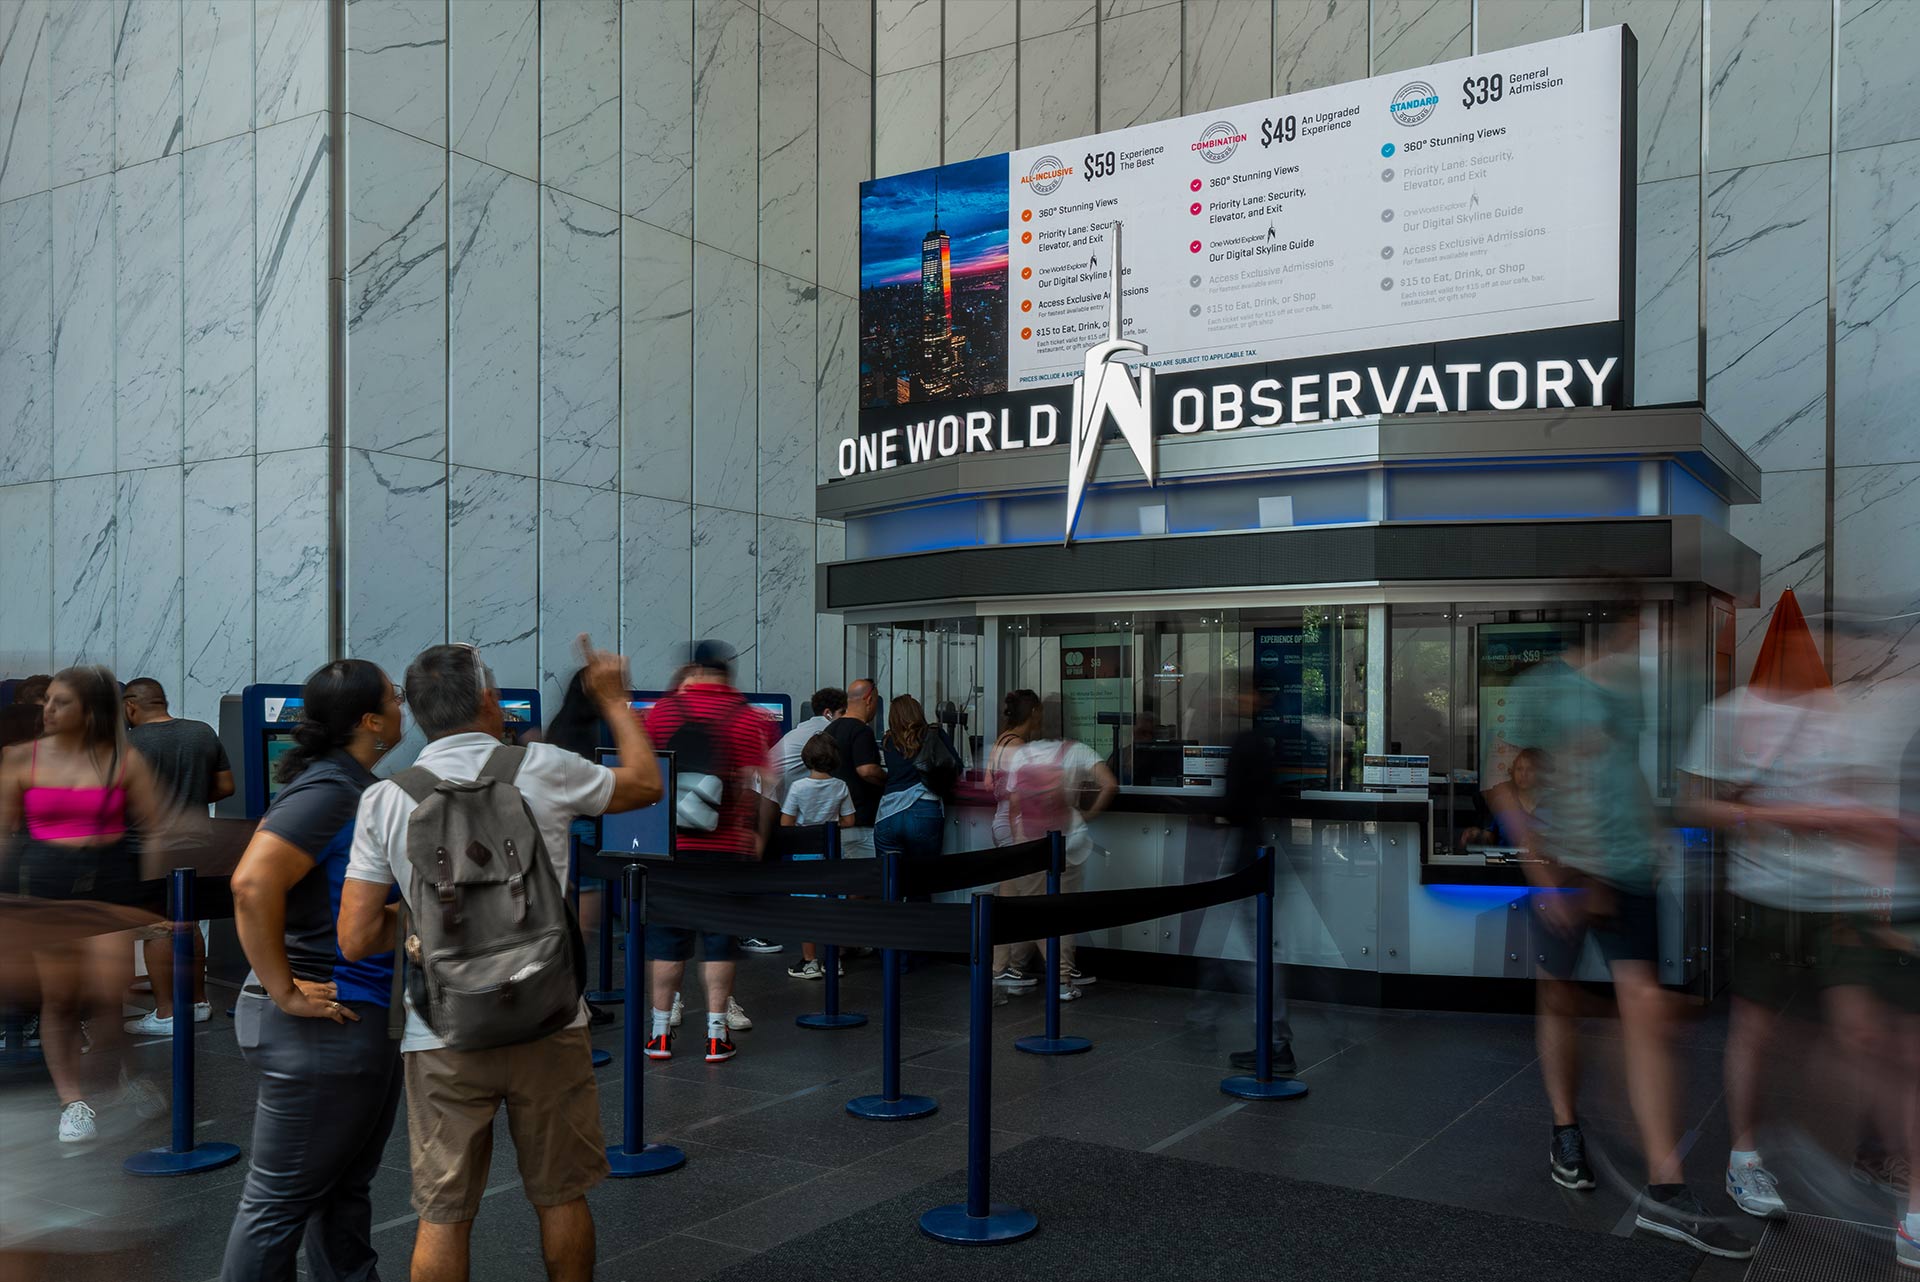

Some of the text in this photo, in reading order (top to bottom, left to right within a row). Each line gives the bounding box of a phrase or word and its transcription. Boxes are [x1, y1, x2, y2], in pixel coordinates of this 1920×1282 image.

[1509, 67, 1549, 84] General
[1462, 73, 1503, 110] $39
[1509, 78, 1563, 95] Admission
[1390, 95, 1439, 113] STANDARD
[1302, 105, 1360, 125] An Upgraded
[1261, 115, 1296, 148] $49
[1302, 120, 1351, 136] Experience
[1191, 134, 1247, 151] COMBINATION
[1403, 126, 1506, 153] 360° Stunning Views
[1120, 146, 1164, 161] Experience
[1084, 151, 1115, 182] $59
[1120, 158, 1154, 171] The Best
[1403, 150, 1514, 178] Priority Lane: Security,
[1021, 167, 1073, 184] ALL-INCLUSIVE
[1210, 165, 1299, 188] 360° Stunning Views
[1403, 168, 1487, 191] Elevator, and Exit
[1039, 198, 1118, 218] 360° Stunning Views
[1210, 188, 1306, 211] Priority Lane: Security,
[1439, 202, 1467, 214] Explorer
[1210, 204, 1283, 224] Elevator, and Exit
[1403, 205, 1524, 232] Our Digital Skyline Guide
[1039, 228, 1066, 240] Priority
[1068, 225, 1089, 236] Lane:
[1241, 234, 1265, 245] Explorer
[1403, 227, 1546, 255] Access Exclusive Admissions
[1039, 234, 1103, 252] Elevator, and Exit
[1209, 238, 1315, 263] Our Digital Skyline Guide
[1067, 262, 1088, 271] Explorer
[1209, 258, 1334, 284] Access Exclusive Admissions
[1400, 263, 1525, 286] $15 to Eat, Drink, or Shop
[1039, 280, 1051, 288] Our
[1054, 274, 1078, 287] Digital
[1080, 271, 1108, 282] Skyline
[1039, 299, 1064, 309] Access
[1067, 292, 1102, 305] Exclusive
[1418, 289, 1436, 297] ticket
[1438, 286, 1454, 294] valid
[1207, 304, 1222, 313] $15
[1225, 303, 1234, 311] to
[1255, 297, 1279, 307] Drink,
[1293, 292, 1316, 302] Shop
[1036, 328, 1050, 336] $15
[1062, 325, 1076, 333] Eat,
[1079, 321, 1100, 331] Drink,
[1019, 374, 1037, 383] PRICES
[1175, 356, 1200, 365] SUBJECT
[1210, 351, 1244, 360] APPLICABLE
[839, 357, 1618, 477] ONE WORLD OBSERVATORY
